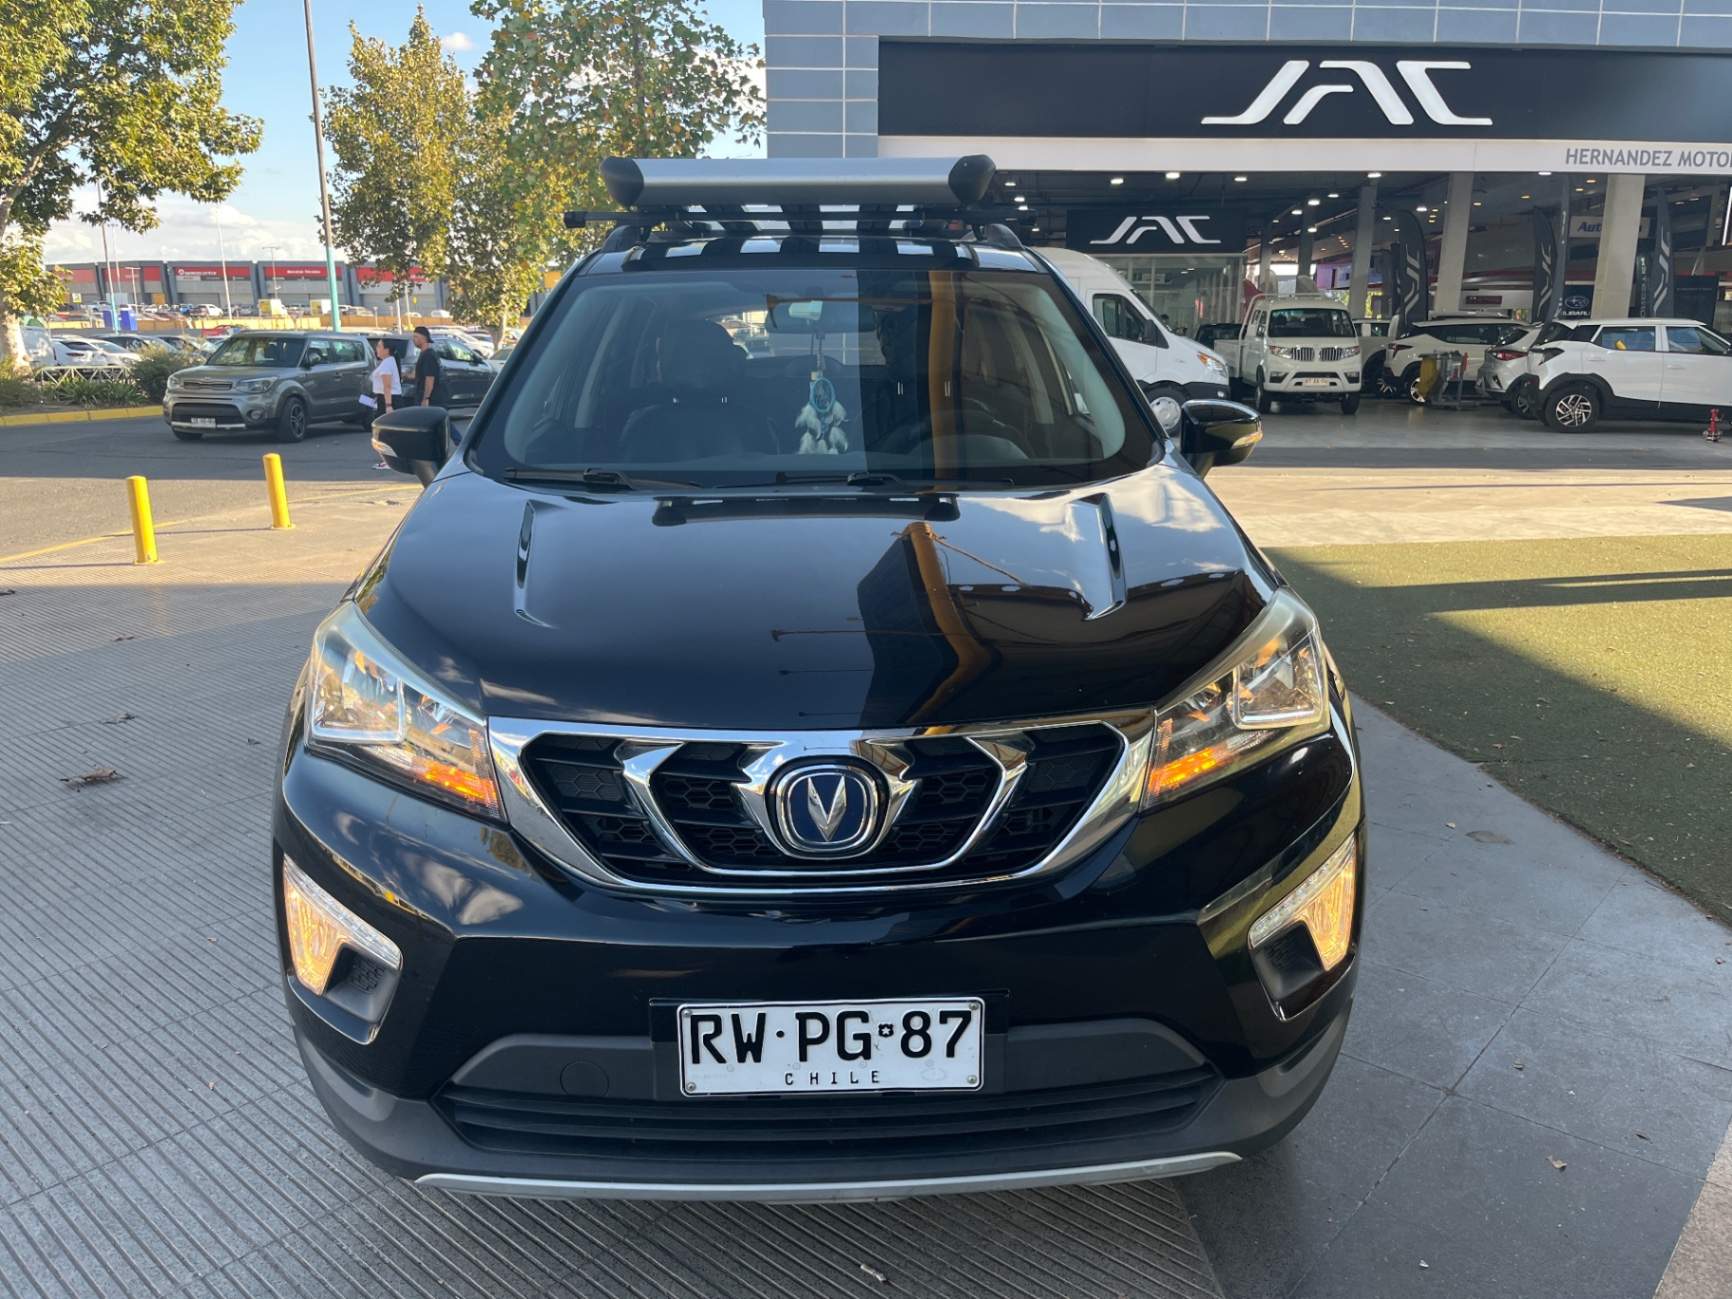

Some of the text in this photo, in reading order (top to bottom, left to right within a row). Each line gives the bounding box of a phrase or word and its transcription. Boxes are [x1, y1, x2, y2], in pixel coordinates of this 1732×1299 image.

[1201, 60, 1493, 125] JAC
[1565, 148, 1673, 167] HERNANDEZ
[1089, 215, 1222, 244] JAC
[784, 1070, 880, 1086] CHILE
